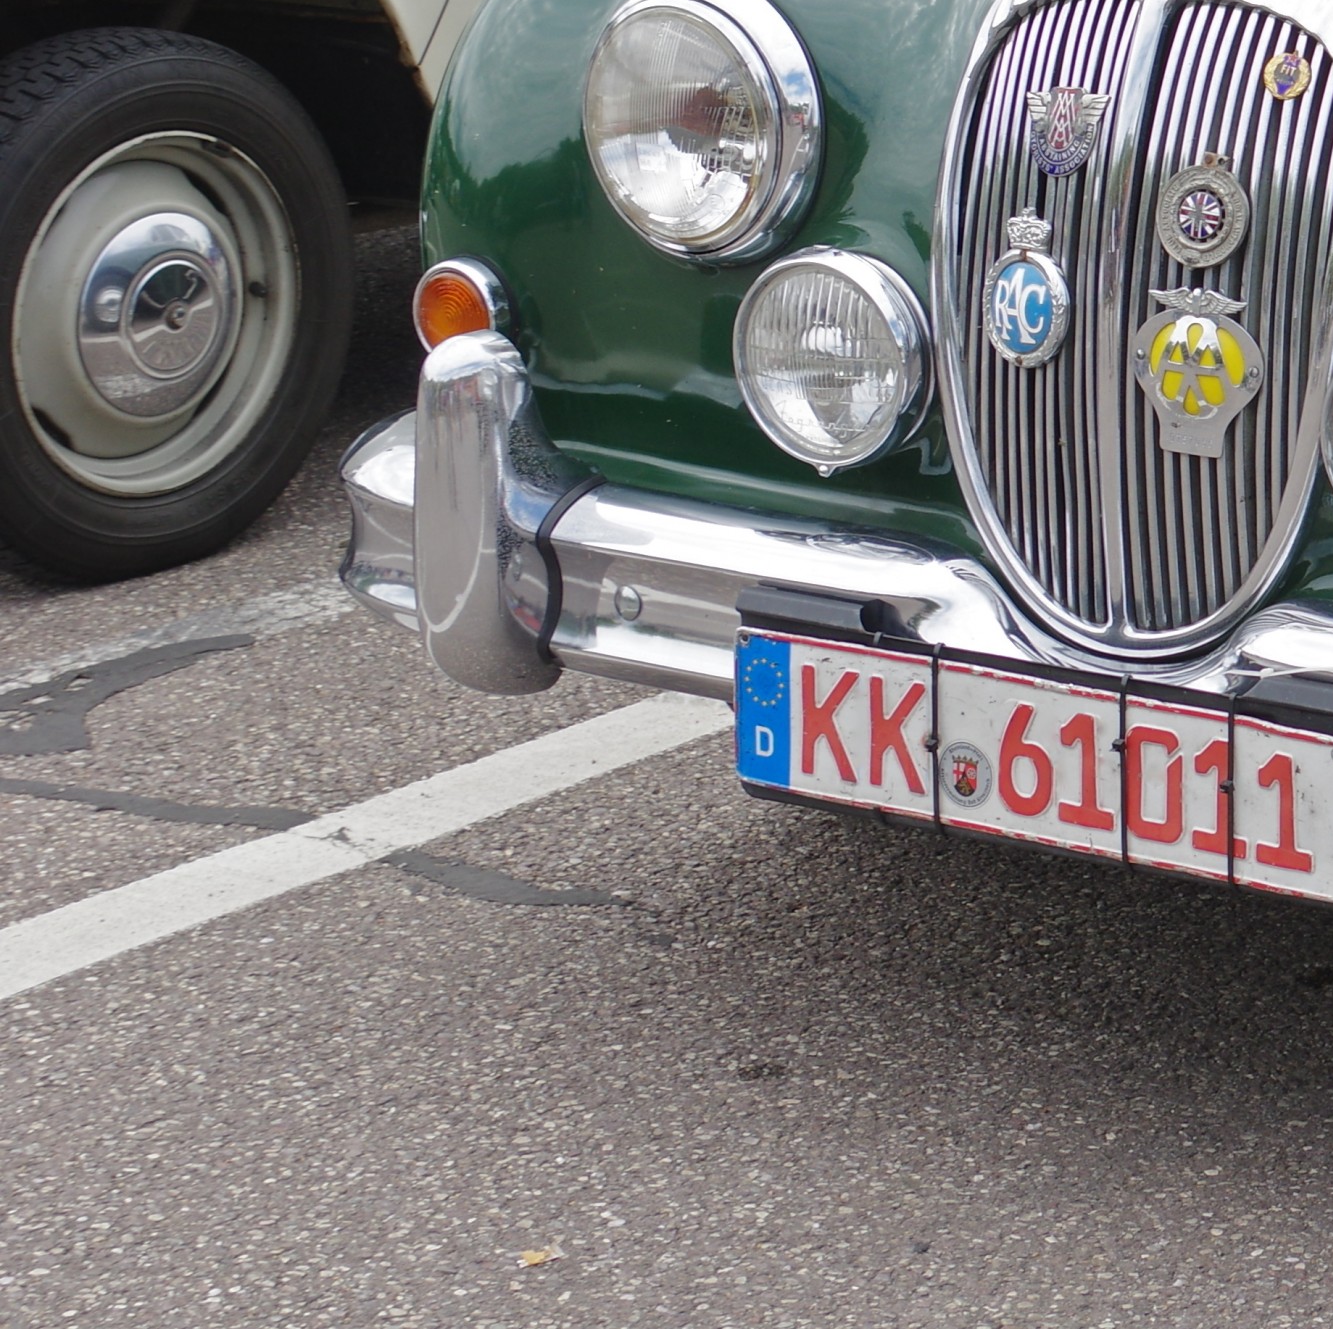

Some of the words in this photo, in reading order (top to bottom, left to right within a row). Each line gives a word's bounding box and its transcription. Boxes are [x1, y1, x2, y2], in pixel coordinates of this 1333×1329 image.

[1038, 137, 1081, 162] ABSTAINING
[1054, 122, 1095, 174] ASSOCIATION
[995, 267, 1047, 345] RAC
[755, 725, 775, 756] D
[800, 663, 926, 797] KK
[998, 700, 1314, 874] 61011
